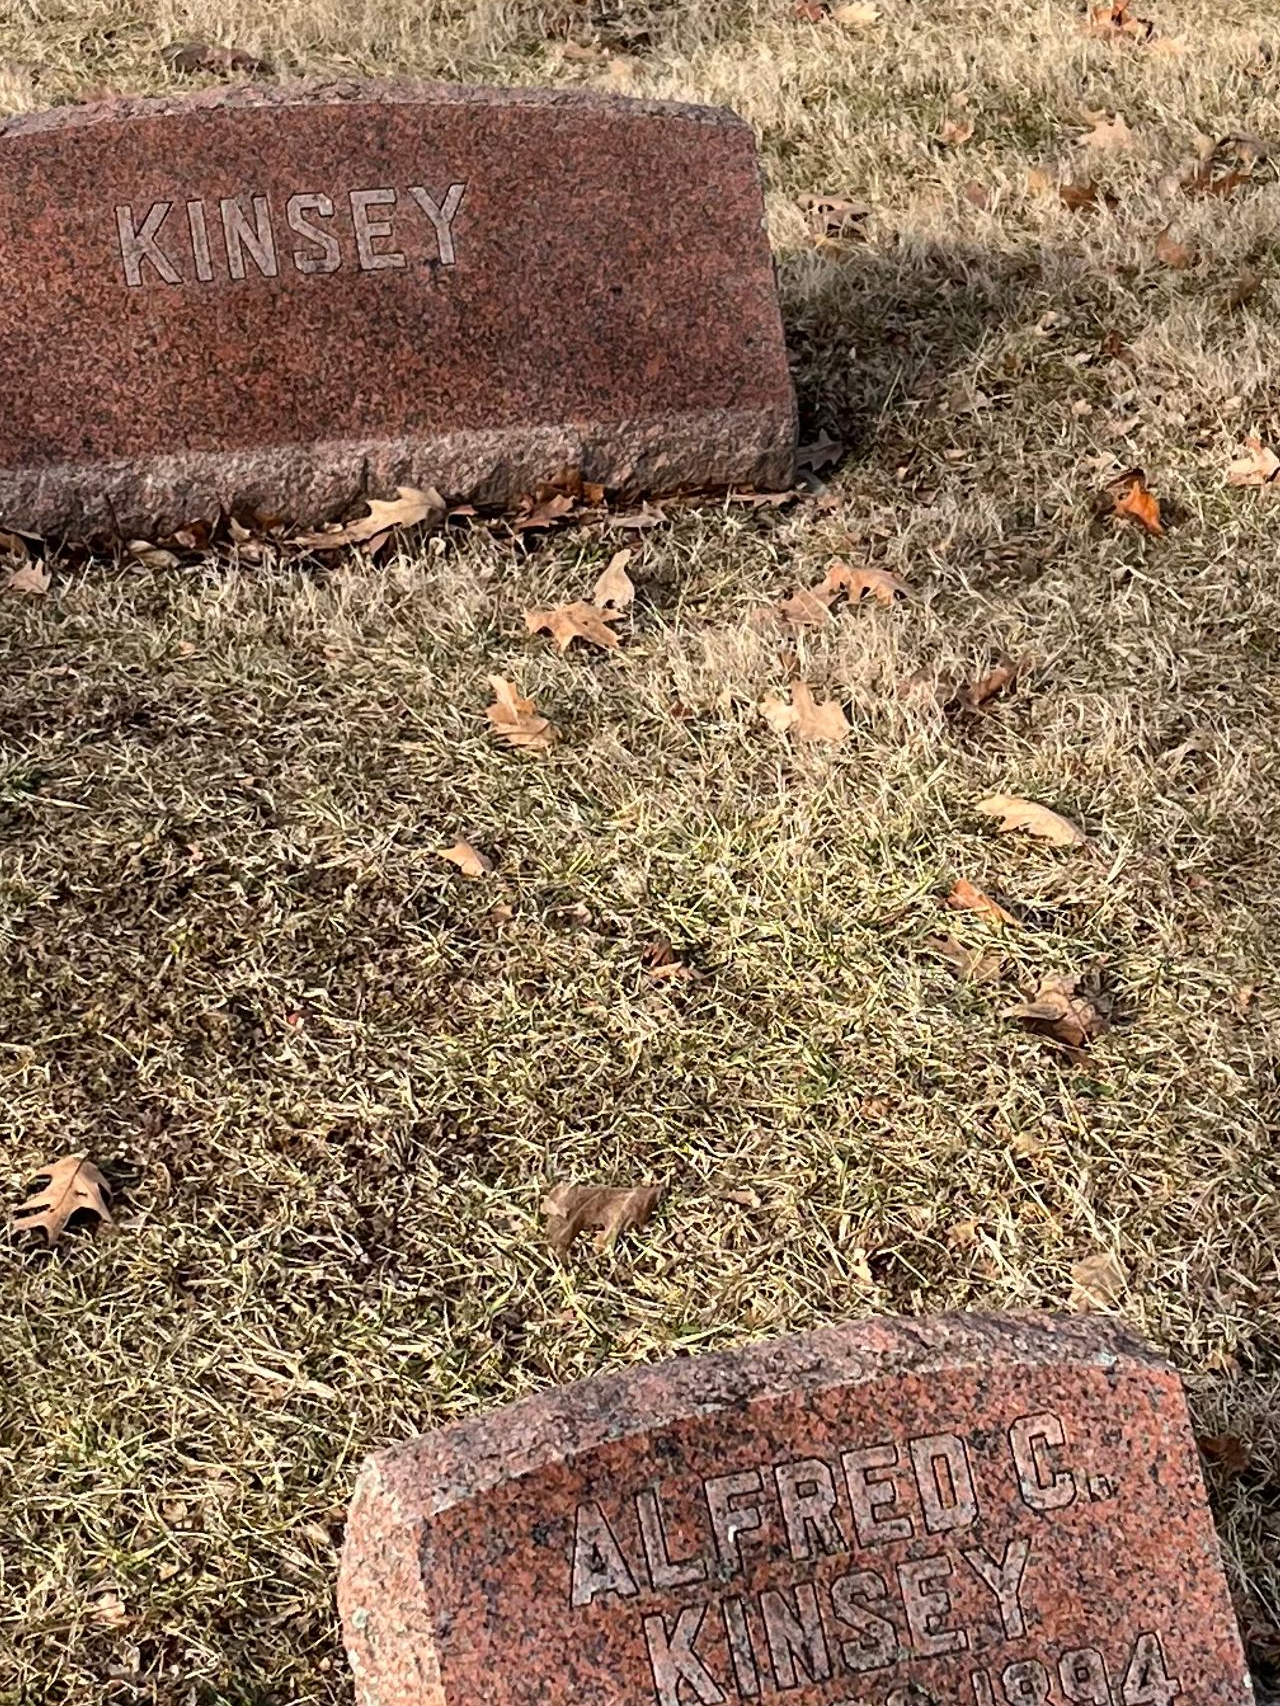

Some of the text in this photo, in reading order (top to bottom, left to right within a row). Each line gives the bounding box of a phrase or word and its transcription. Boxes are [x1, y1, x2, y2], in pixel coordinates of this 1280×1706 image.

[115, 182, 467, 287] KINSEY
[568, 1410, 1112, 1610] ALFRED C.
